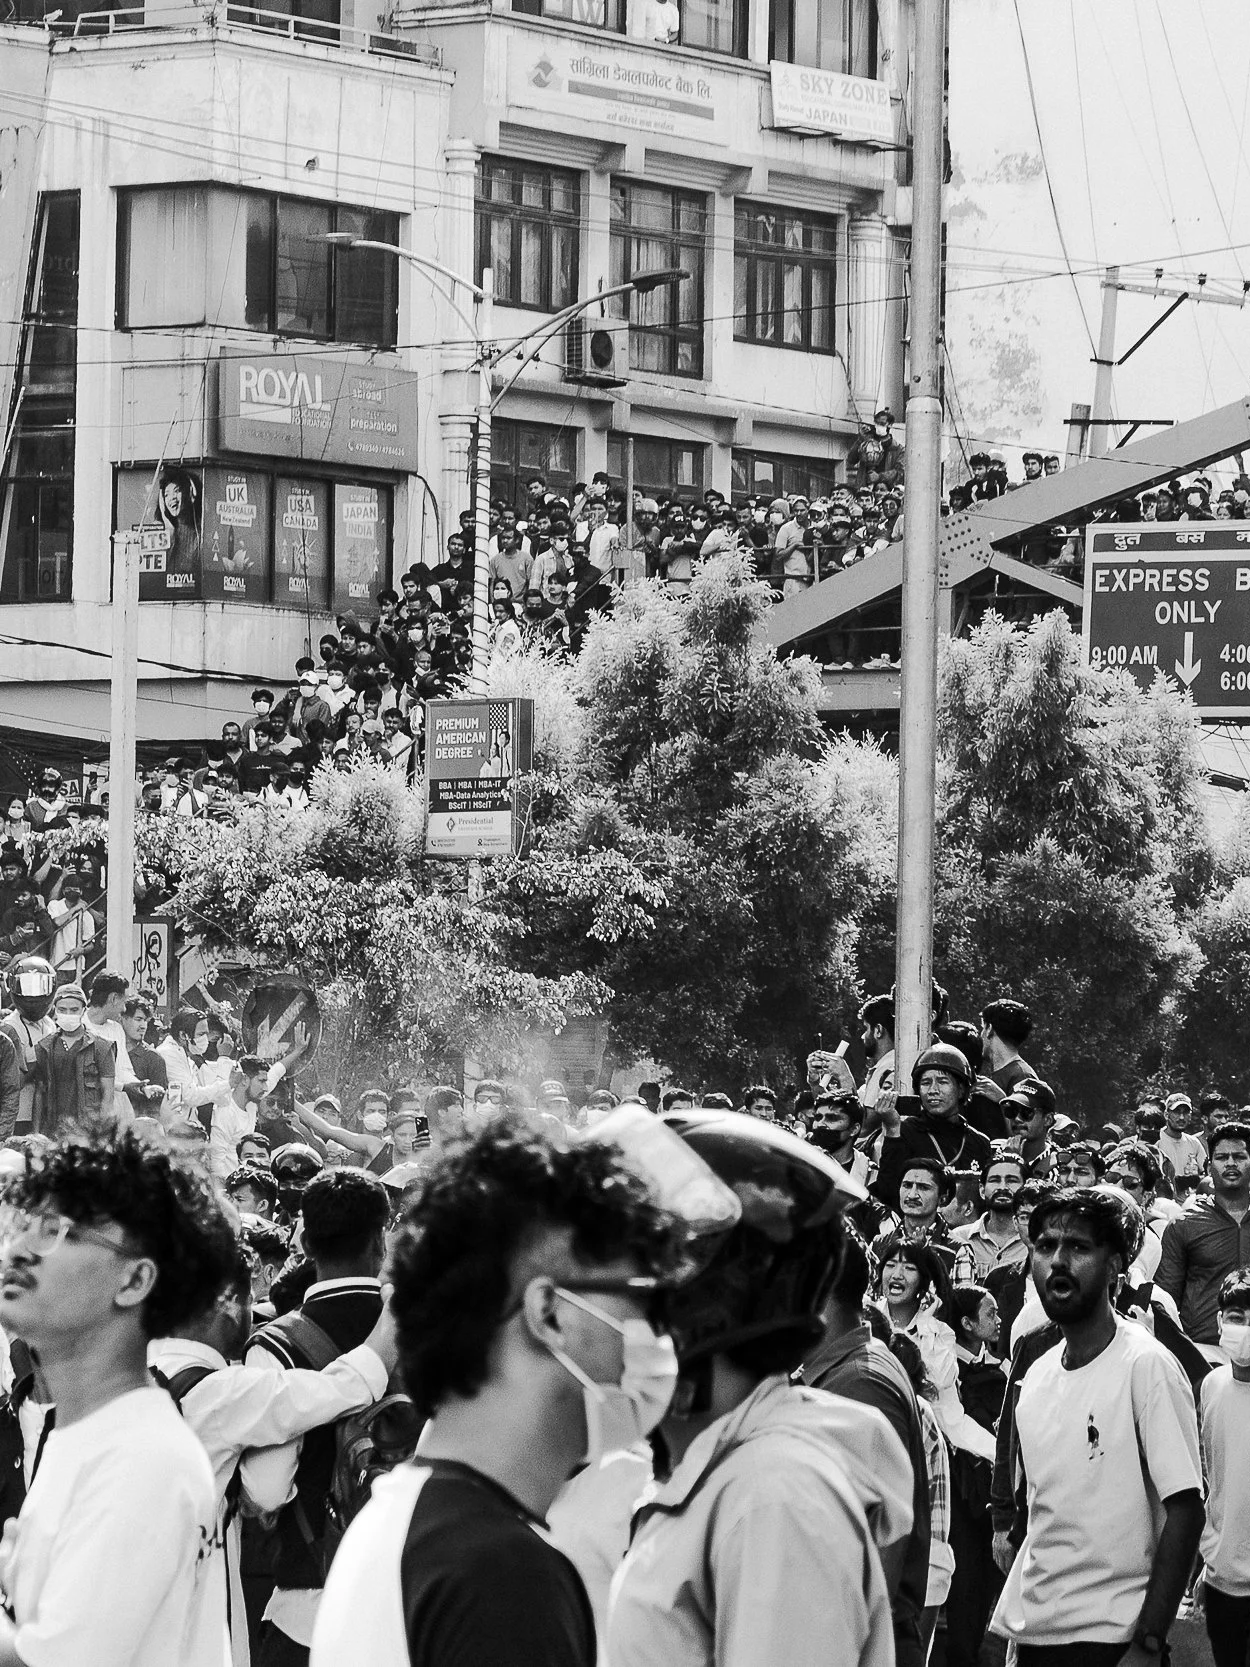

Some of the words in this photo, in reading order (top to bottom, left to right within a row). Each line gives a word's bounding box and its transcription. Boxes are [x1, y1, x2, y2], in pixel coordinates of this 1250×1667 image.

[800, 73, 834, 96] SKY
[841, 81, 888, 105] ZONE
[806, 107, 848, 125] JAPAN
[239, 365, 331, 411] ROYAL
[350, 418, 398, 433] preparation
[228, 487, 245, 502] UK
[218, 504, 254, 517] AUSTRALIA
[290, 498, 313, 513] USA
[344, 507, 377, 519] JAPAN
[284, 517, 317, 529] CANADA
[348, 523, 372, 536] INDIA
[1176, 531, 1206, 543] बस
[166, 573, 195, 584] ROYAL
[1094, 568, 1211, 592] EXPRESS
[1154, 600, 1222, 625] ONLY
[1092, 645, 1127, 665] 9:00
[1129, 645, 1158, 665] AM
[435, 717, 479, 731] PREMIUM
[435, 732, 486, 745] AMERICAN
[435, 746, 474, 760] DEGREE
[438, 781, 452, 790] BBA
[458, 781, 472, 789] MBA
[478, 780, 501, 788] MBA-IT
[440, 791, 471, 800] MBA-Data
[472, 790, 501, 800] Analytics
[448, 801, 467, 810] BScIT
[458, 817, 494, 825] Presidential
